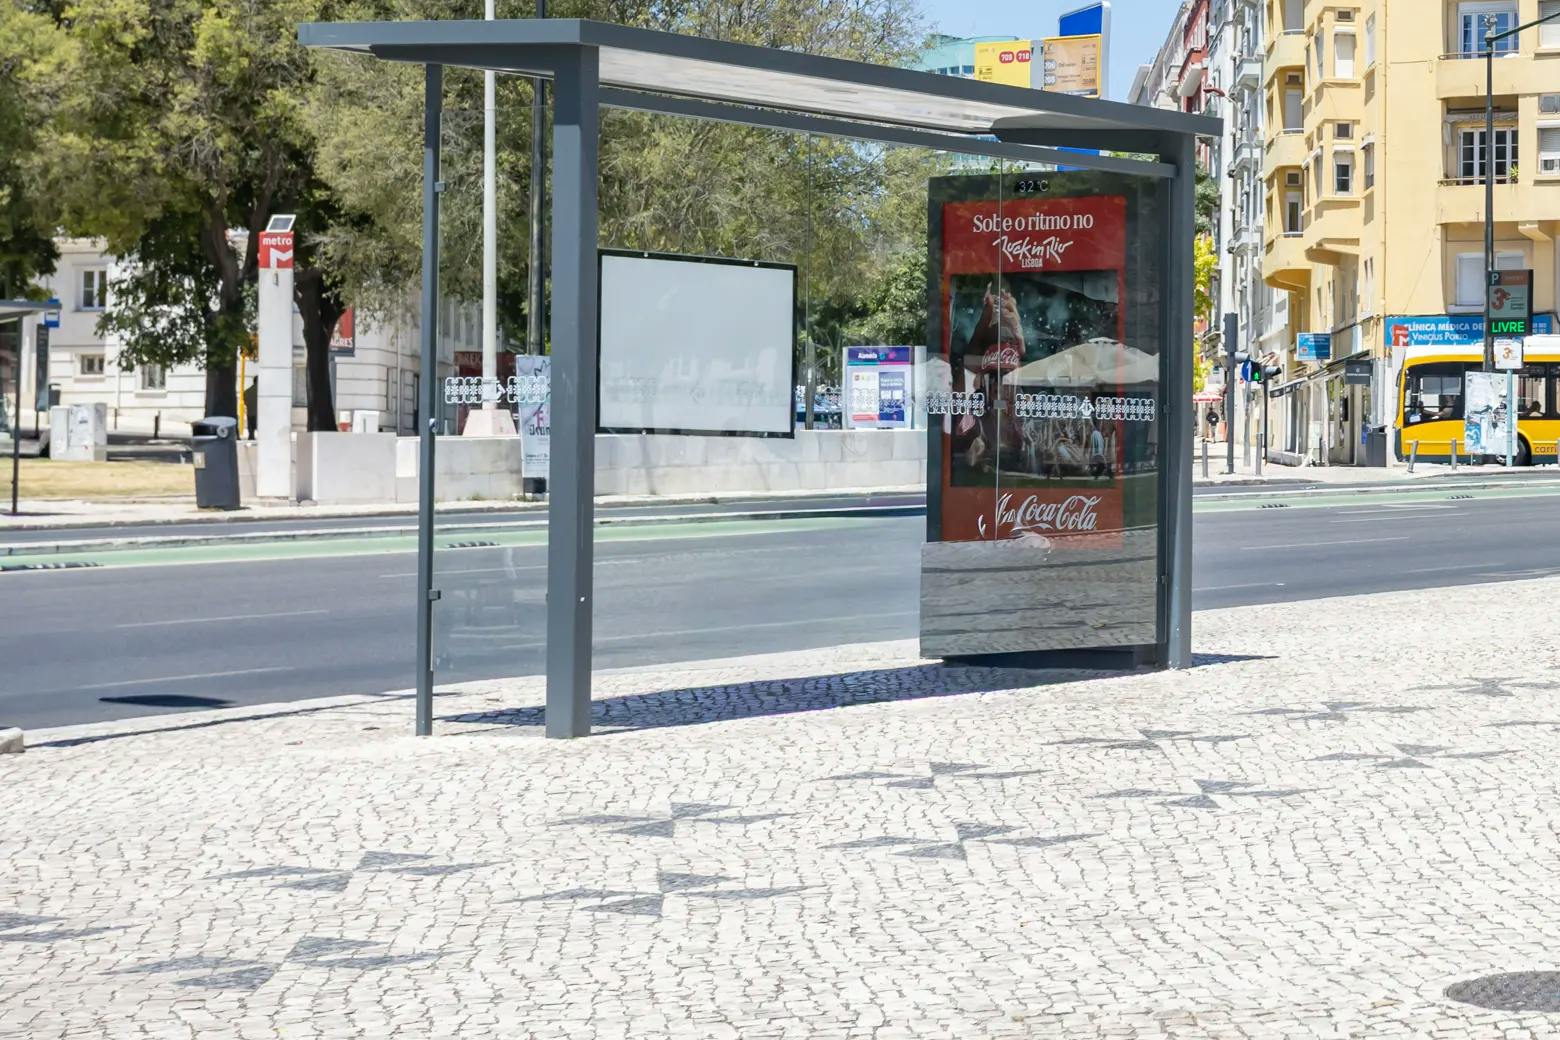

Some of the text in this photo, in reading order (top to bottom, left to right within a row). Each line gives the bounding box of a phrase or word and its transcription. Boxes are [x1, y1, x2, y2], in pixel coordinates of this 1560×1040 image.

[1019, 181, 1034, 192] 32
[973, 212, 1094, 233] Sobe o ritmo no
[263, 237, 292, 245] metro
[1021, 259, 1043, 268] LISBOA
[1437, 321, 1470, 331] MÉDICA
[1491, 321, 1525, 333] LIVRE
[330, 338, 353, 347] AGRES
[1535, 446, 1558, 454] carri
[1012, 495, 1102, 531] Coca-Cola
